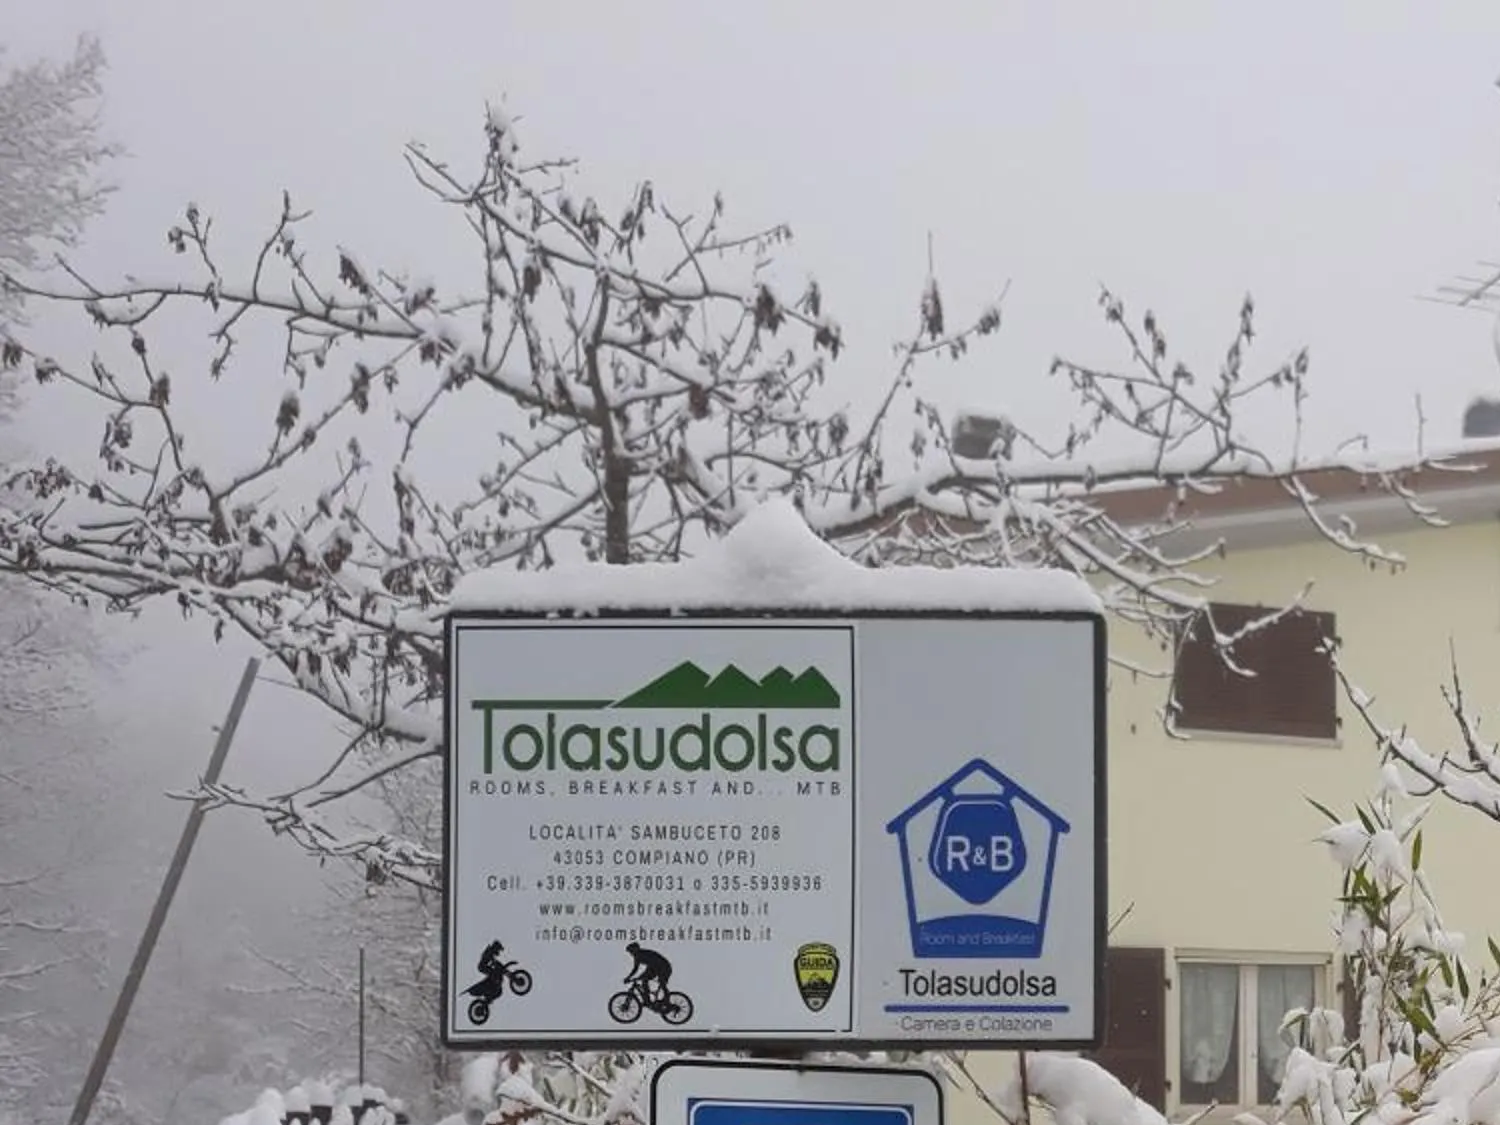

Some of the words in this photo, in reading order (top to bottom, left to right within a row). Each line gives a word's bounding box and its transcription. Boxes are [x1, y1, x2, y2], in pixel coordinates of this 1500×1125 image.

[472, 700, 841, 774] Tolasudolsa
[568, 780, 698, 796] BREAKFAST
[797, 781, 843, 797] MTB
[529, 825, 623, 841] LOCALITA'
[631, 825, 742, 841] SAMBUCETO
[751, 825, 782, 841] 208
[553, 850, 605, 866] 43053
[613, 850, 709, 866] COMPIANO
[717, 849, 757, 868] (PR)
[946, 835, 1014, 872] R&B
[487, 875, 528, 891] Cell.
[538, 901, 769, 917] www.roomsbreakfastmtb.it
[535, 925, 772, 943] info@roomsbreakfastmtb.it
[898, 969, 1057, 997] Tolasudolsa
[900, 1015, 962, 1032] Camera
[965, 1018, 976, 1032] e
[979, 1015, 1054, 1032] Colazione
